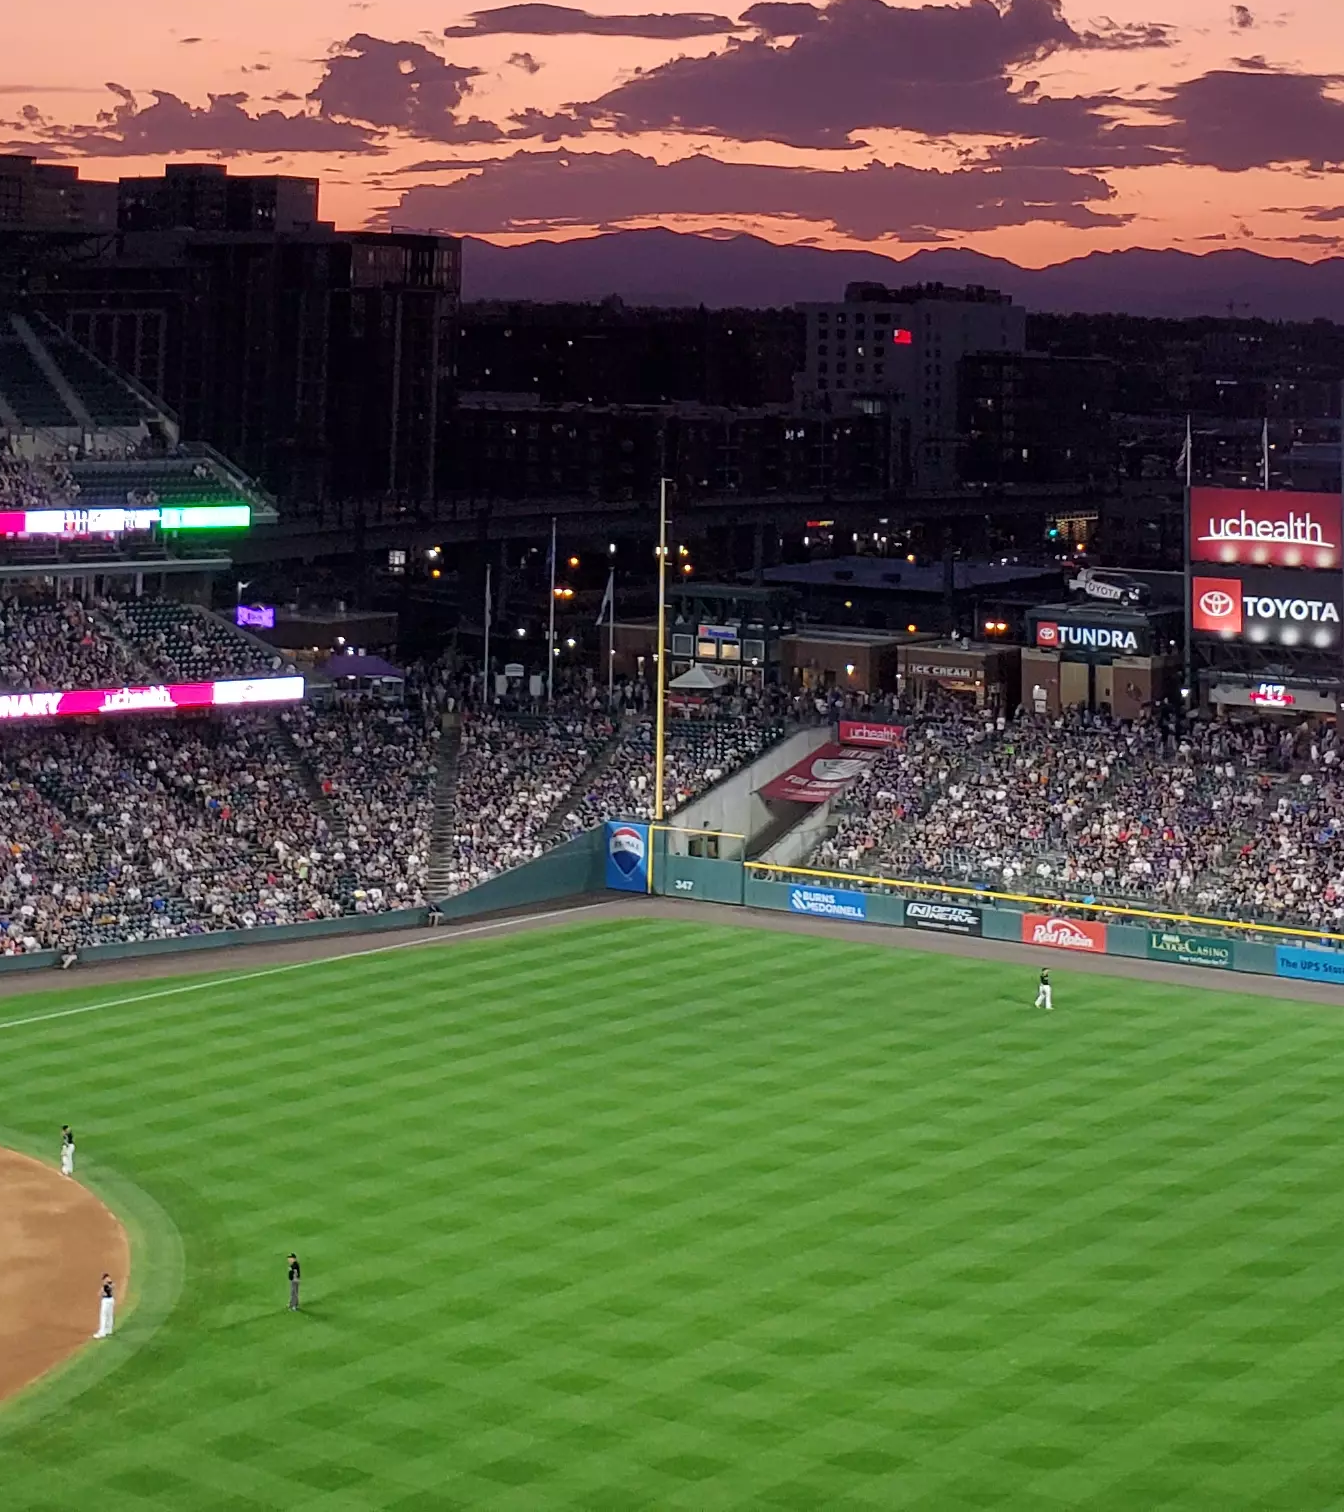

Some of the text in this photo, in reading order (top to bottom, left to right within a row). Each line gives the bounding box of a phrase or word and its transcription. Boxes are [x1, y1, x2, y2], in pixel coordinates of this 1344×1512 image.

[1209, 509, 1323, 544] uchealth
[1243, 596, 1340, 623] TOYOTA
[1057, 626, 1138, 648] TUNDRA
[912, 664, 971, 678] ICE CREAM
[849, 724, 898, 739] uchealth
[675, 879, 694, 891] 347
[802, 891, 835, 903] BURNS
[931, 904, 973, 916] OPTIC
[929, 912, 981, 925] NERVE
[1033, 924, 1094, 949] Red Robin
[1185, 938, 1229, 958] CASINO
[1280, 957, 1298, 970] The
[1301, 960, 1321, 972] UPS
